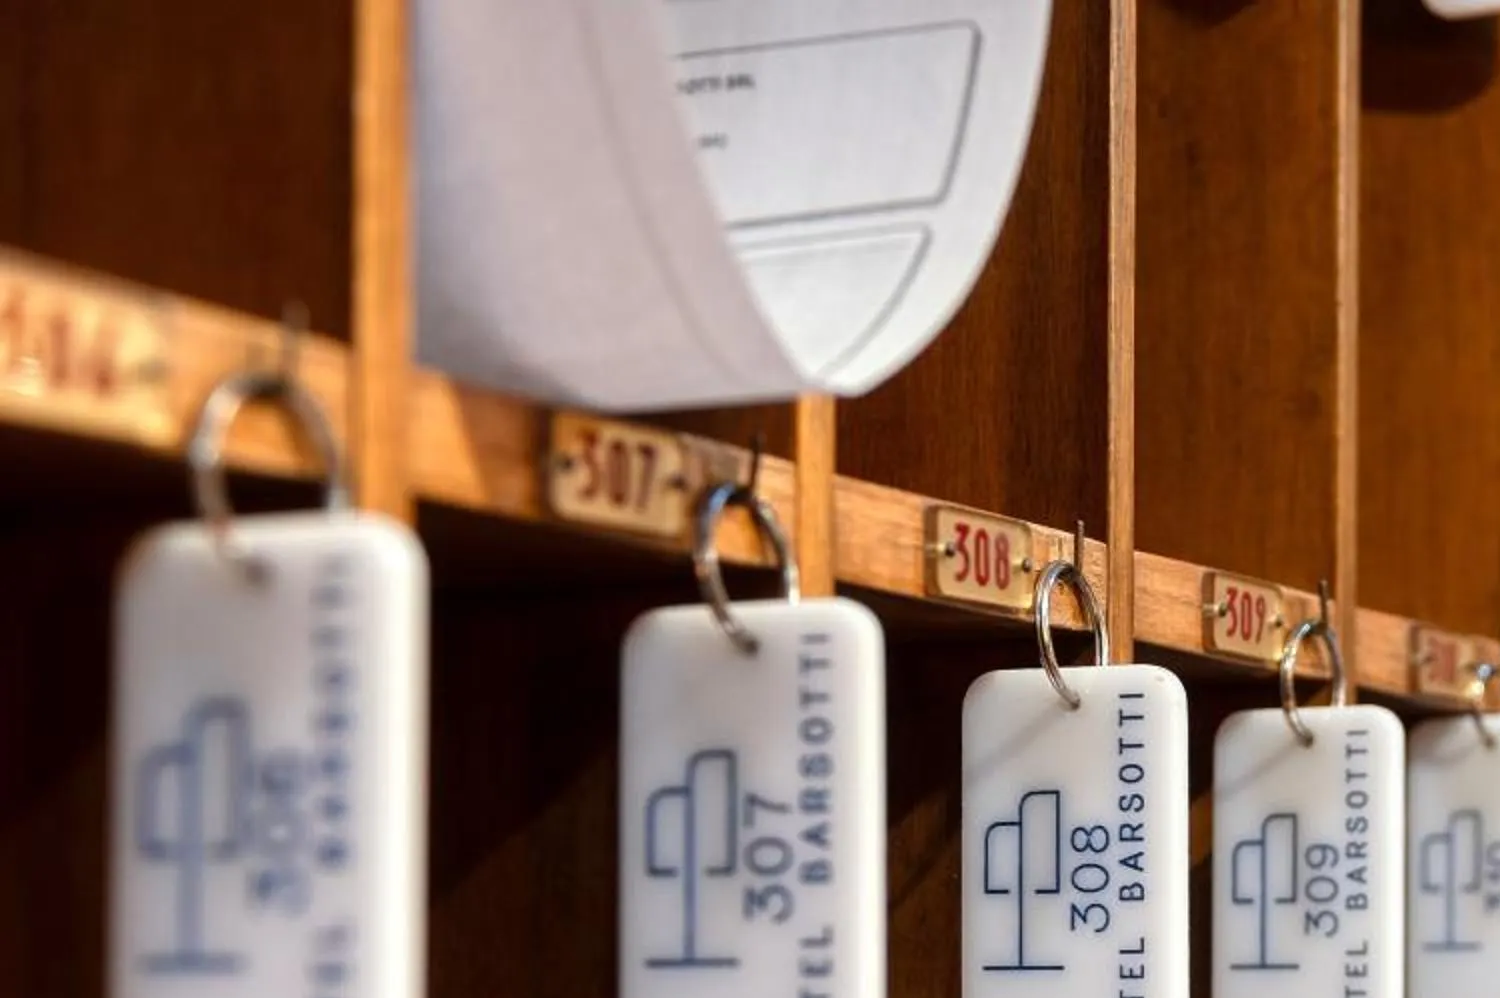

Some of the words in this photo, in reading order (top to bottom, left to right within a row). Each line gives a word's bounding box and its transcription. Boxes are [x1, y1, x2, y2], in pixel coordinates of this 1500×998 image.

[577, 426, 655, 511] 307
[954, 520, 1009, 590] 308
[1226, 586, 1265, 645] 309
[798, 635, 832, 885] BARSOTTI
[1118, 694, 1144, 901] BARSOTTI
[250, 750, 309, 908] 306
[743, 790, 795, 924] 307
[1070, 825, 1110, 932] 308
[1344, 731, 1368, 911] BARSOTTI
[1303, 844, 1339, 937] 309
